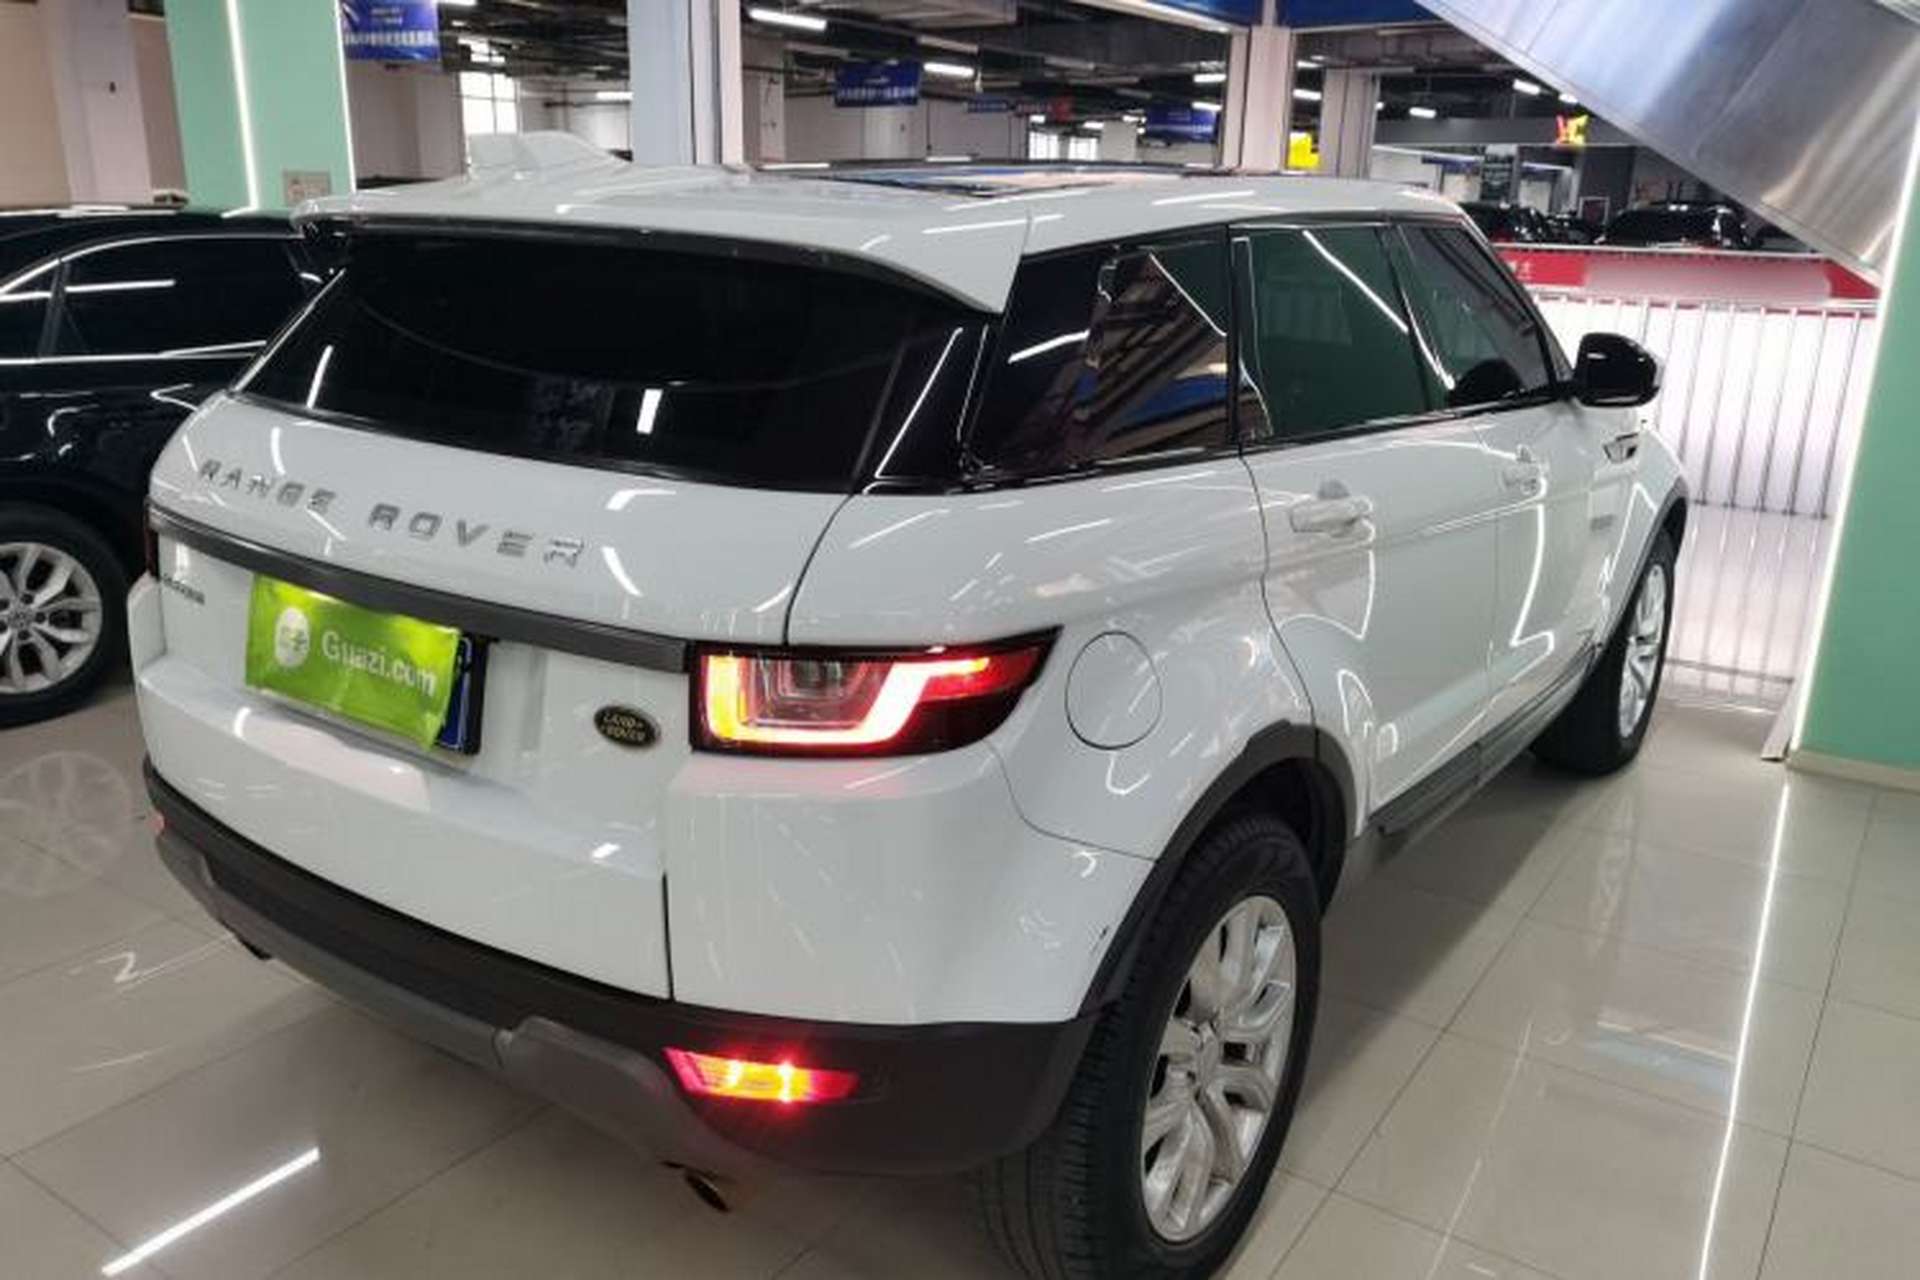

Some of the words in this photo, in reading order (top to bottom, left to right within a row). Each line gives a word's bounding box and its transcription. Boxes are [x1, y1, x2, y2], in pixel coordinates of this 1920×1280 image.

[200, 459, 337, 515] RANGE
[368, 502, 585, 568] ROVER
[322, 629, 436, 697] Guazi.com
